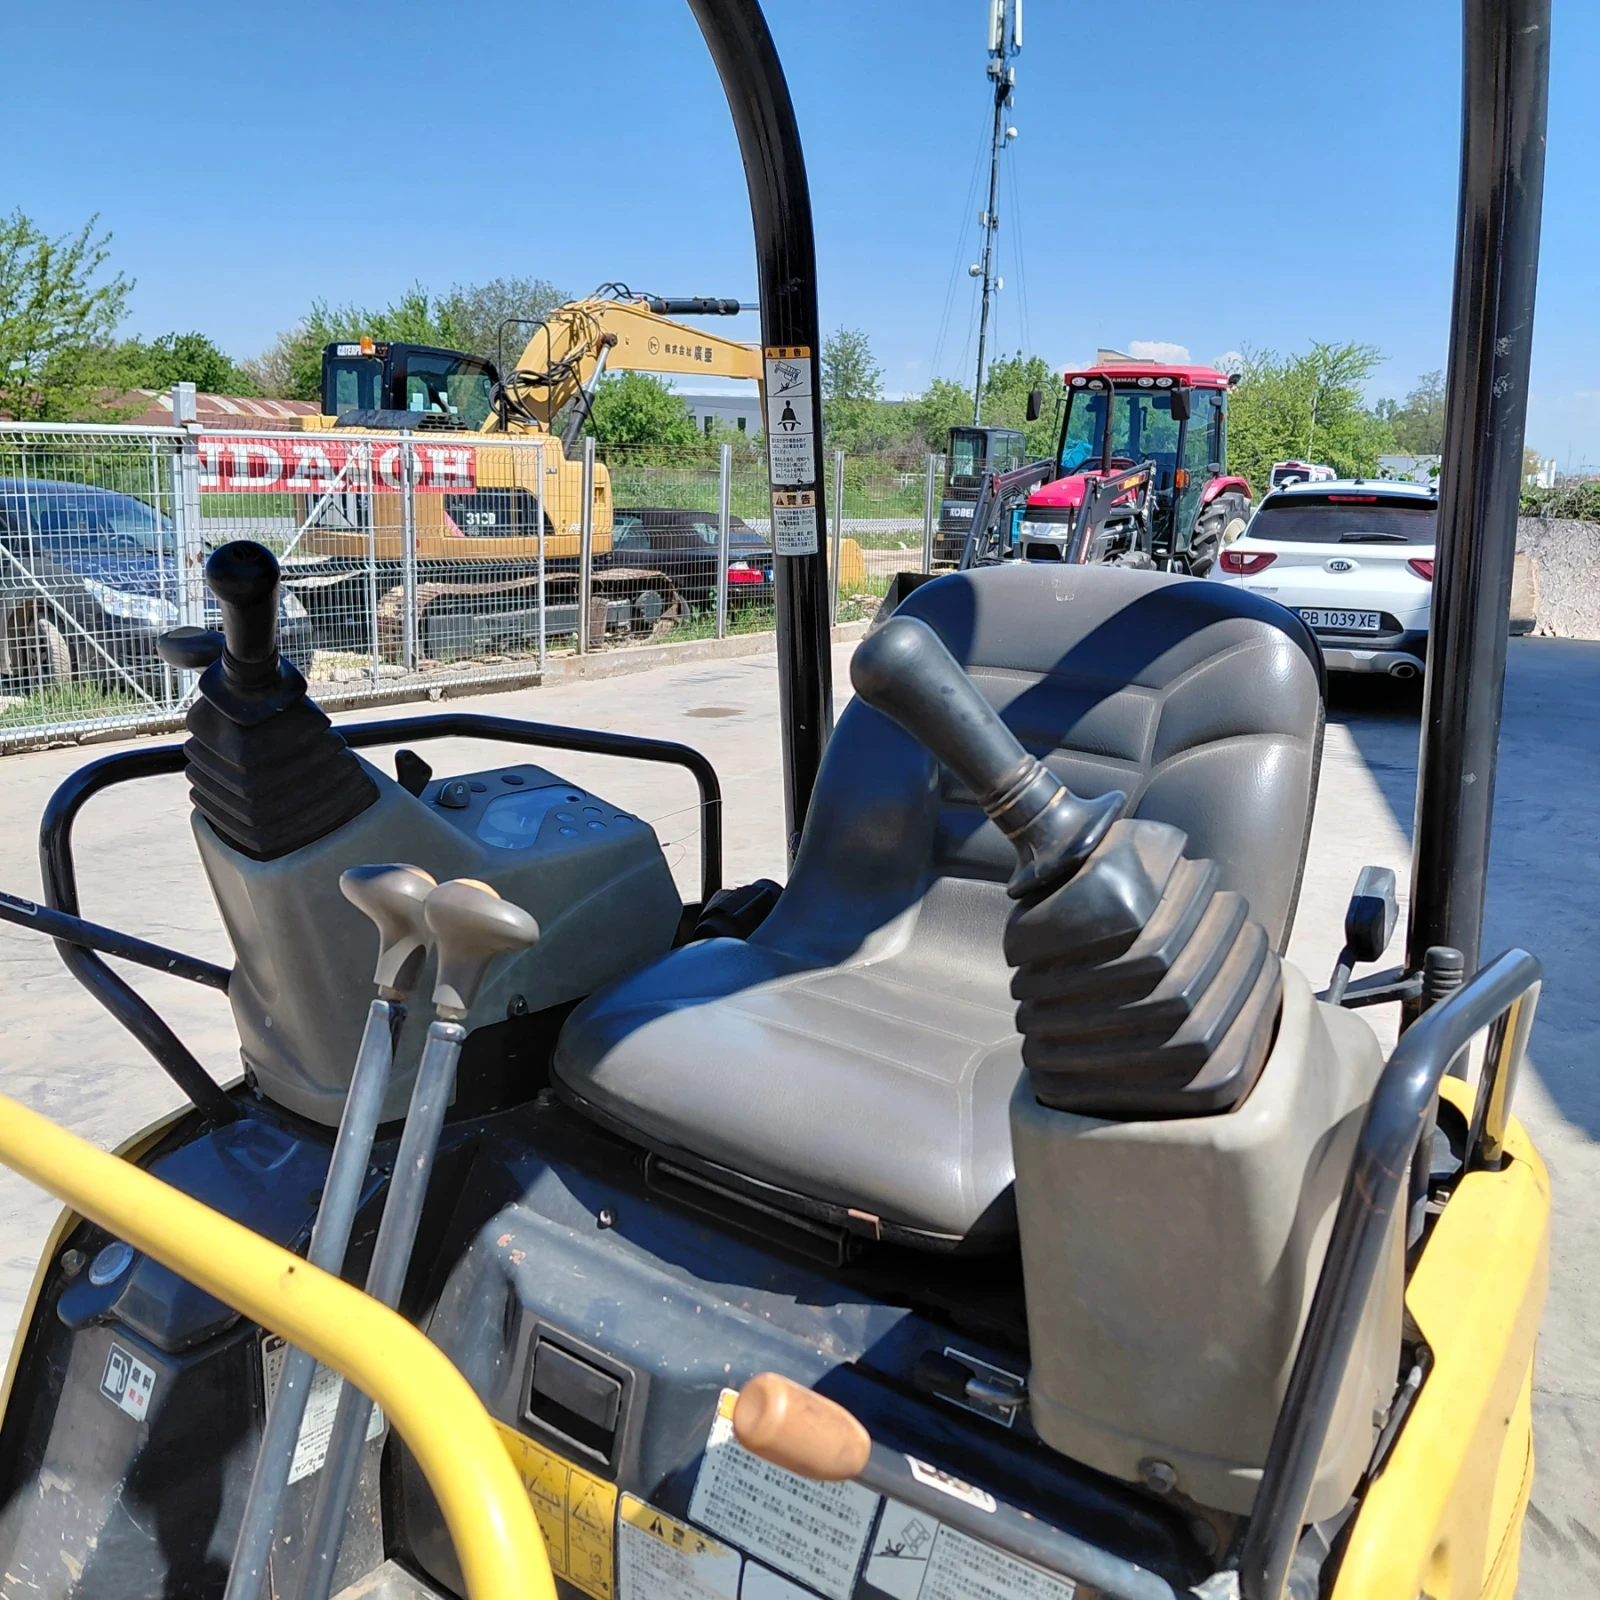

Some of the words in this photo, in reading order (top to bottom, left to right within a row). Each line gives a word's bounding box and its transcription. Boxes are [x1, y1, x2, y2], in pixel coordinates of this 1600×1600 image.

[1301, 611, 1319, 625] PB
[1324, 612, 1356, 626] 1039
[1358, 614, 1377, 628] XE
